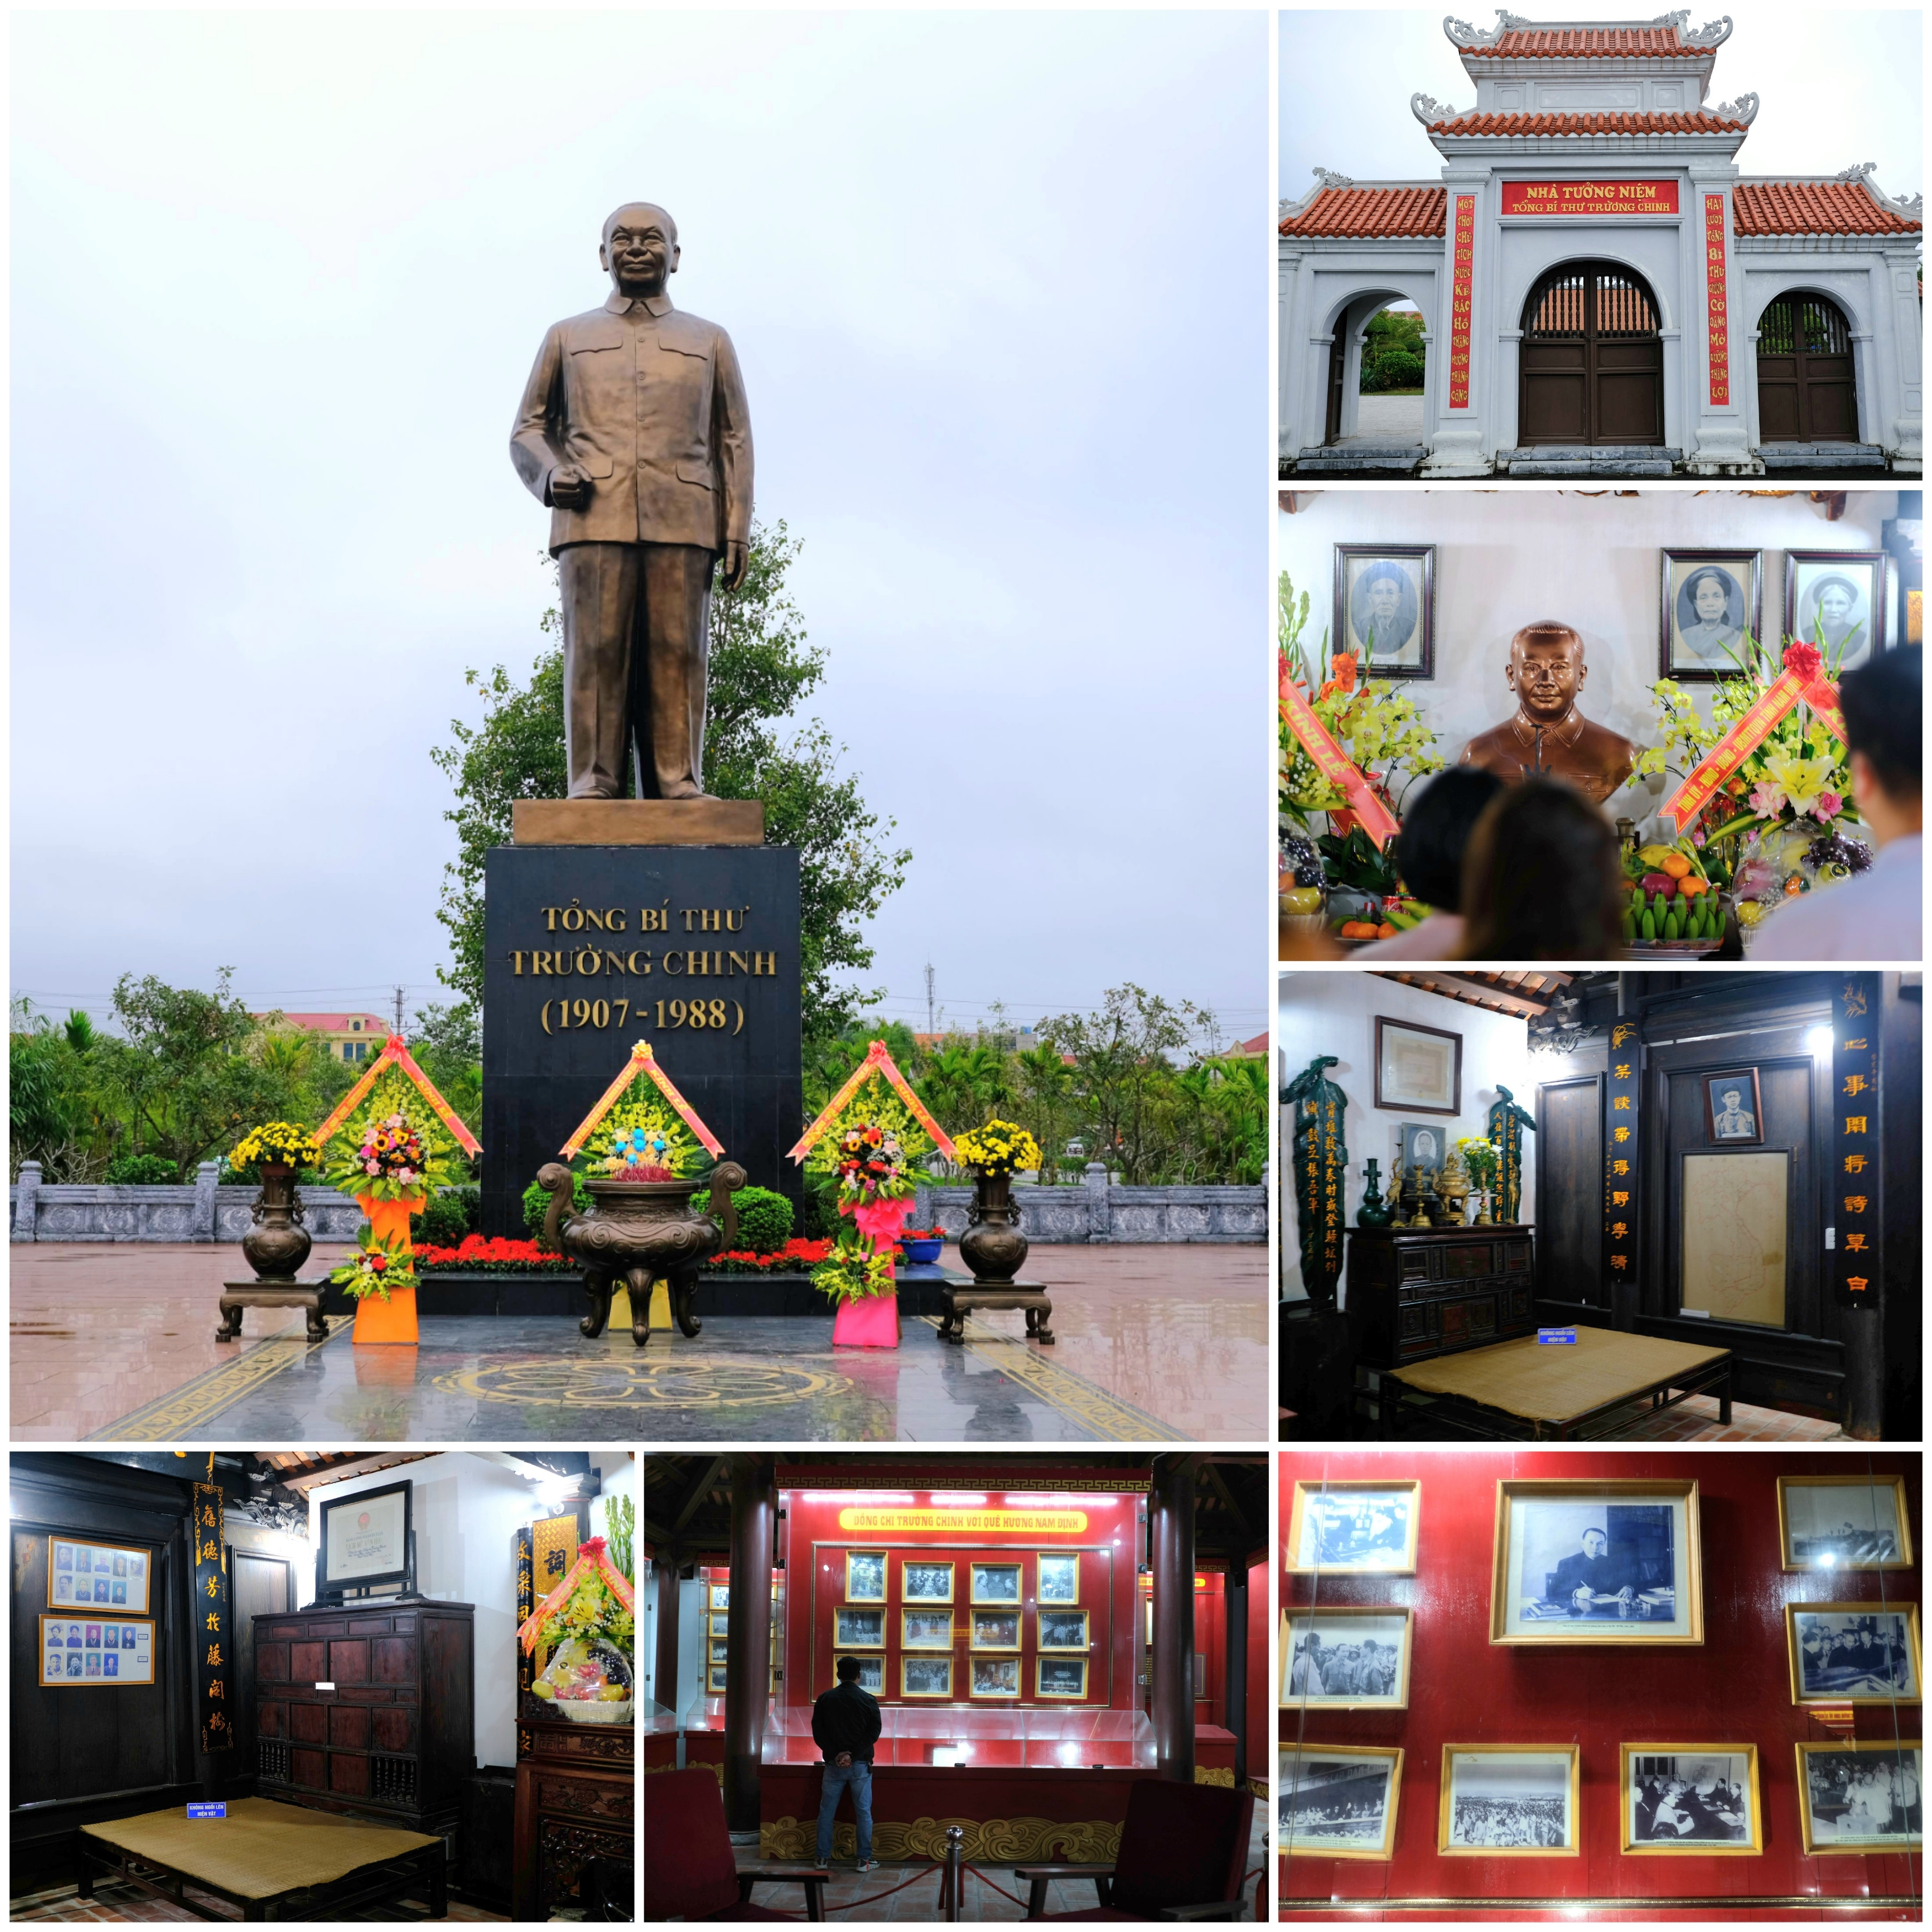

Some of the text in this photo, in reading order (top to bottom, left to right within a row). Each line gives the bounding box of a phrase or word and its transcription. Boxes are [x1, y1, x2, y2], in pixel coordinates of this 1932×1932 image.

[1562, 182, 1615, 199] TƯỞNG
[1619, 183, 1656, 202] NIỆM
[1457, 199, 1474, 210] MỘT
[1512, 200, 1544, 212] TỔNG
[1545, 201, 1558, 212] BÍ
[1561, 202, 1585, 212] THƯ
[1638, 203, 1670, 212] CHINH
[1706, 198, 1722, 210] HAI
[1457, 214, 1472, 227] THỜI
[1707, 214, 1723, 225] LƯỢT
[1456, 231, 1472, 244] CHỦ
[1456, 249, 1472, 260] TỊCH
[1454, 299, 1470, 312] BÁC
[1710, 298, 1725, 311] CỜ
[1453, 316, 1469, 330] HỒ
[1710, 332, 1726, 346] MỞ
[1451, 389, 1467, 402] CÔNG
[1712, 386, 1728, 399] LỢI
[1770, 689, 1791, 709] NAM
[1758, 702, 1779, 723] TỈNH
[1283, 699, 1325, 748] KÍNH
[1714, 747, 1737, 771] UBND
[1685, 784, 1704, 800] ỦY
[1675, 793, 1697, 814] TỈNH
[542, 898, 750, 931] TỔNG BÍ THƯ
[508, 943, 777, 976] TRƯỜNG CHINH
[897, 1513, 933, 1527] TRƯỜNG
[936, 1516, 963, 1527] CHINH
[984, 1515, 1000, 1528] QUÊ
[1003, 1516, 1033, 1528] HƯƠNG
[1036, 1518, 1055, 1528] NAM
[1058, 1518, 1078, 1530] ĐỊNH
[601, 1567, 629, 1597] KÍNH
